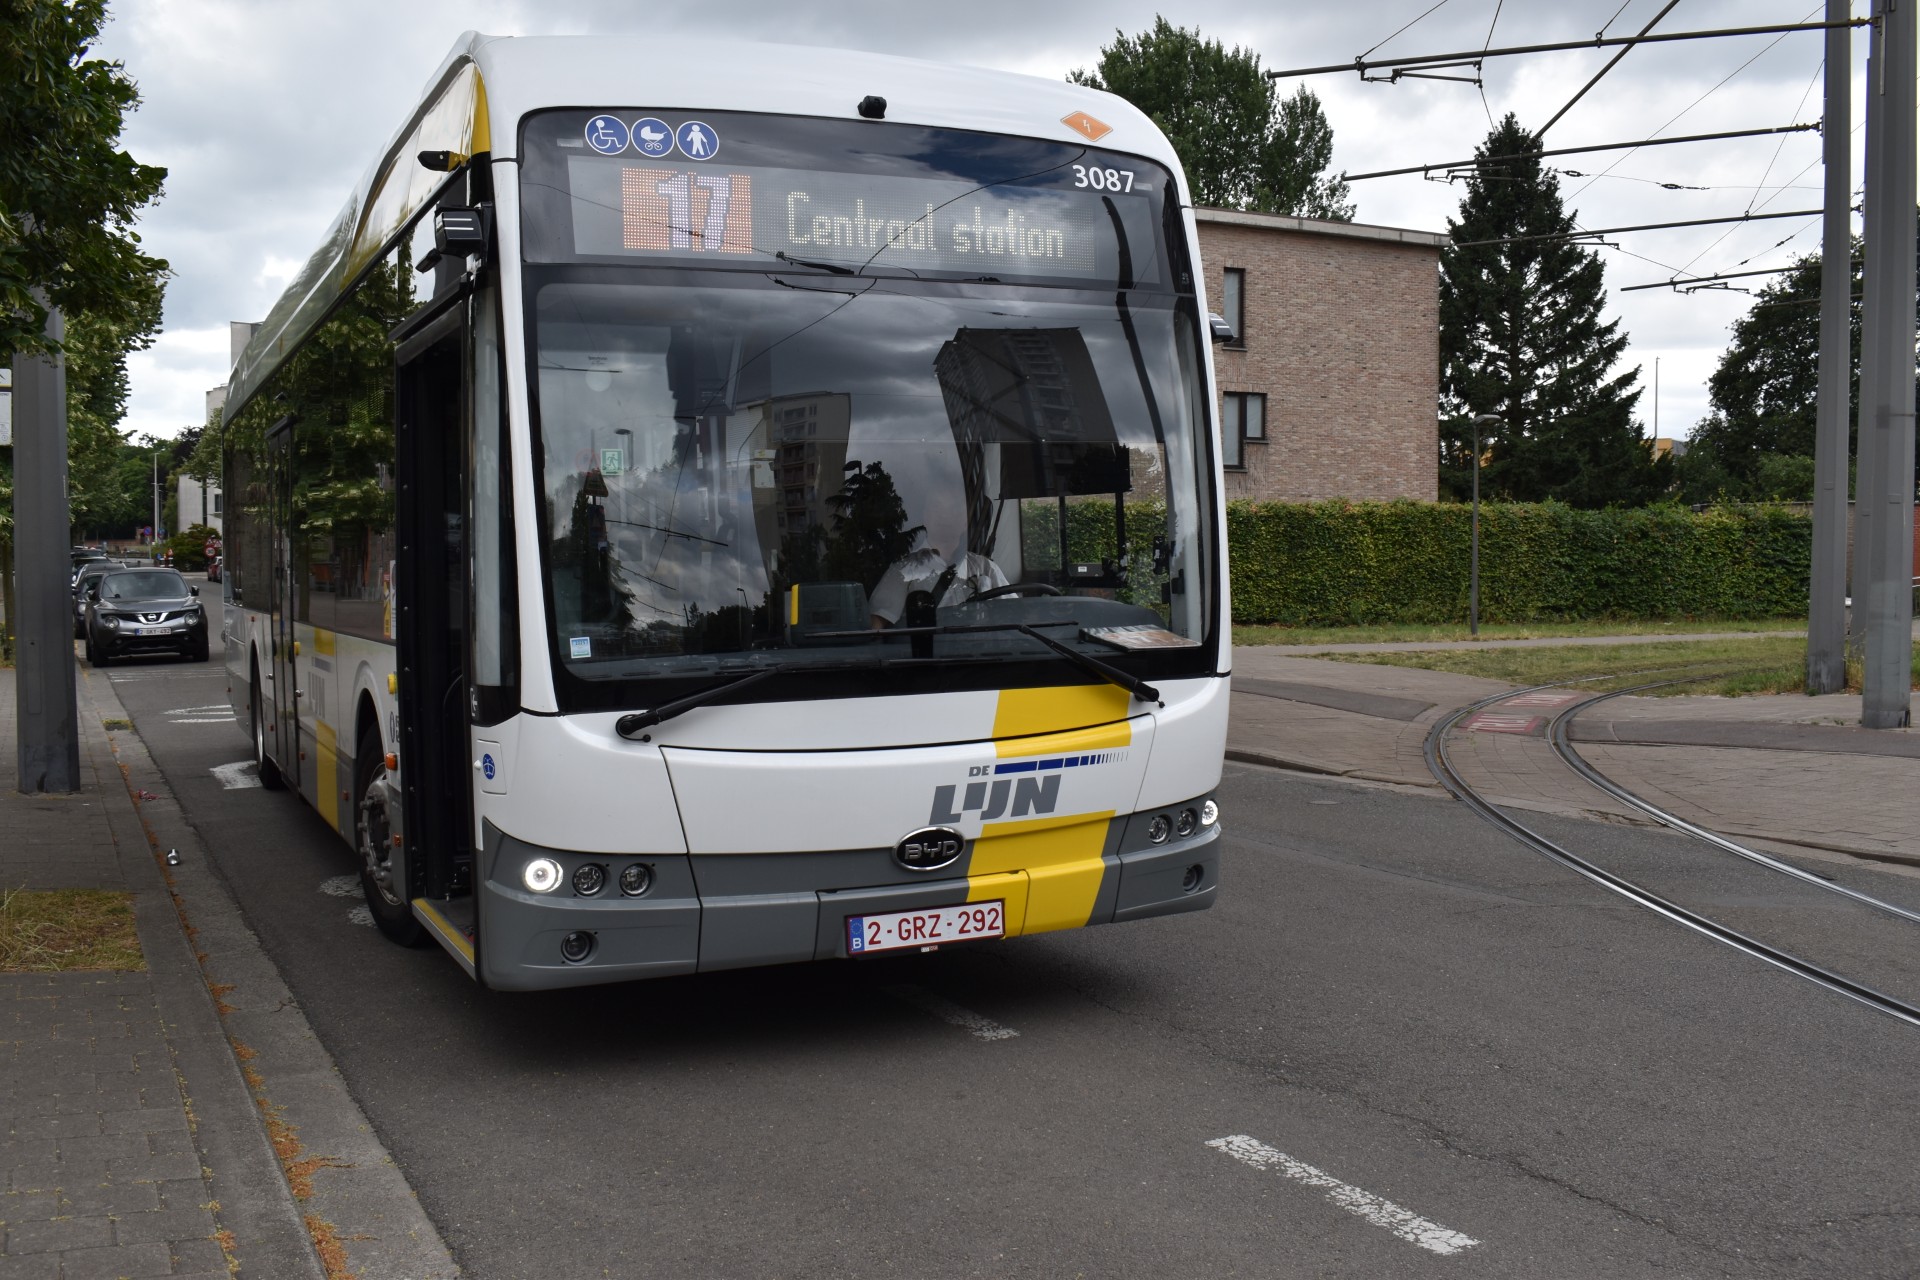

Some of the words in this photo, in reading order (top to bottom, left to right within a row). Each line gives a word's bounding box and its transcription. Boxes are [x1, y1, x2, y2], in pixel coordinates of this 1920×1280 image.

[1072, 164, 1134, 193] 3087
[658, 174, 730, 250] 17
[787, 191, 937, 251] Centraal
[953, 206, 1063, 258] station
[968, 765, 990, 778] DE
[928, 774, 1062, 826] LIJN
[904, 840, 959, 860] BYD
[852, 937, 862, 949] B
